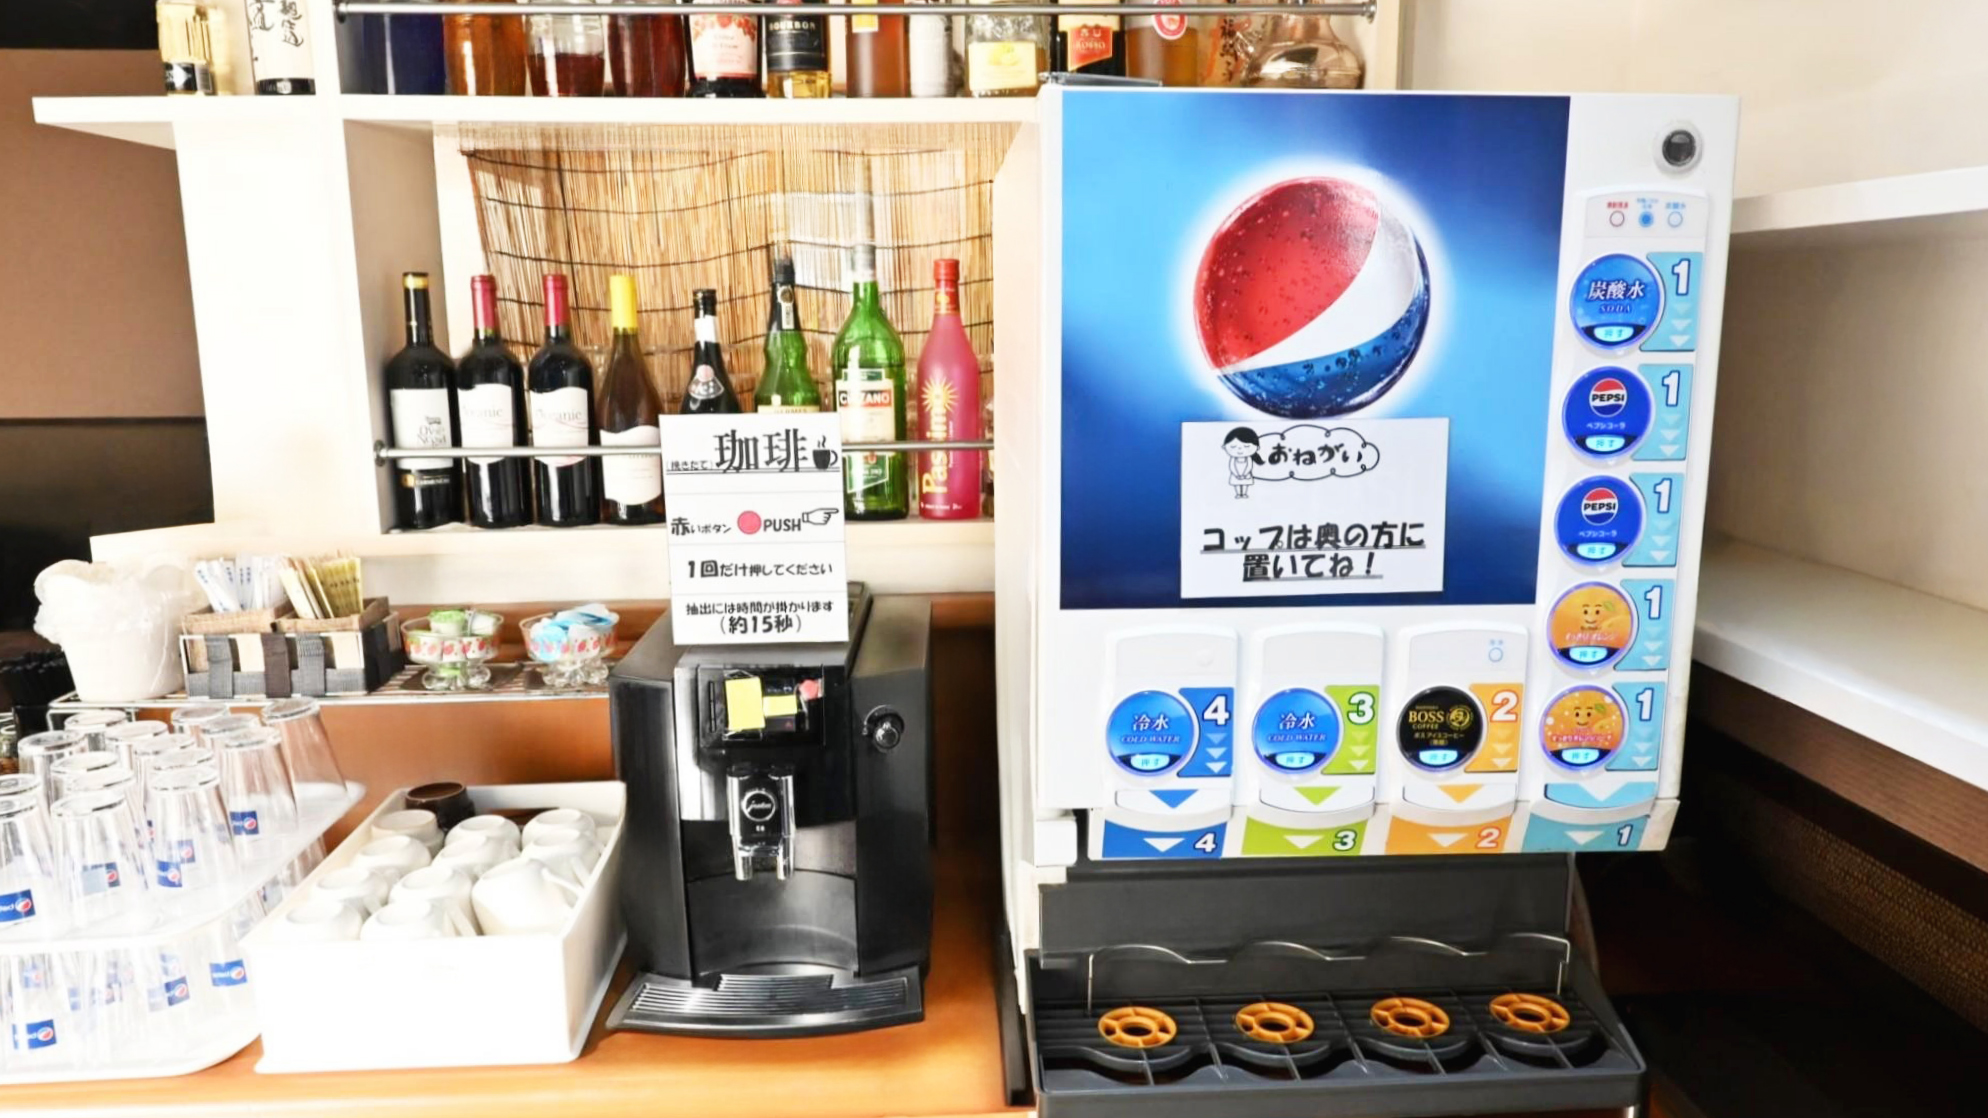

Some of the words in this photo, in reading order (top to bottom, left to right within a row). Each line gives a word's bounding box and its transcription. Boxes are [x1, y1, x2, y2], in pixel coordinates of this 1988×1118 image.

[1672, 258, 1691, 296] 1
[1588, 279, 1645, 301] 炭酸水
[1599, 304, 1632, 313] SODA
[839, 391, 890, 404] CZANO
[1591, 393, 1625, 402] PEPSI
[1661, 370, 1680, 407] 1
[1586, 422, 1626, 430] ペプシコーラ
[713, 428, 808, 473] 珈琲
[922, 390, 948, 494] Pasimo
[1268, 442, 1364, 466] おねがい
[1653, 477, 1672, 514] 1
[1583, 502, 1616, 511] PEPSI
[671, 517, 731, 536] 赤いボタン
[763, 518, 801, 532] PUSH
[1579, 530, 1617, 538] ペプシコーラ
[1203, 521, 1425, 551] コップは奥の方に
[688, 560, 833, 578] 1回だけ押してください
[1243, 552, 1375, 582] 置いてね!
[686, 600, 833, 615] 抽出には時間が掛かります
[1644, 585, 1663, 620] 1
[720, 614, 802, 635] (約15秒)
[1202, 694, 1231, 725] 4
[1347, 691, 1375, 725] 3
[1490, 689, 1519, 723] 2
[1636, 687, 1654, 722] 1
[1133, 714, 1169, 731] 冷水
[1280, 712, 1315, 730] 冷水
[1408, 711, 1445, 723] BOSS
[1412, 723, 1439, 731] COFFEE
[1149, 735, 1181, 743] WATER
[1268, 734, 1293, 742] COLD
[1295, 733, 1326, 741] WATER
[1193, 832, 1217, 853] 4
[1332, 830, 1357, 852] 3
[1476, 828, 1500, 849] 2
[1617, 824, 1633, 847] 1
